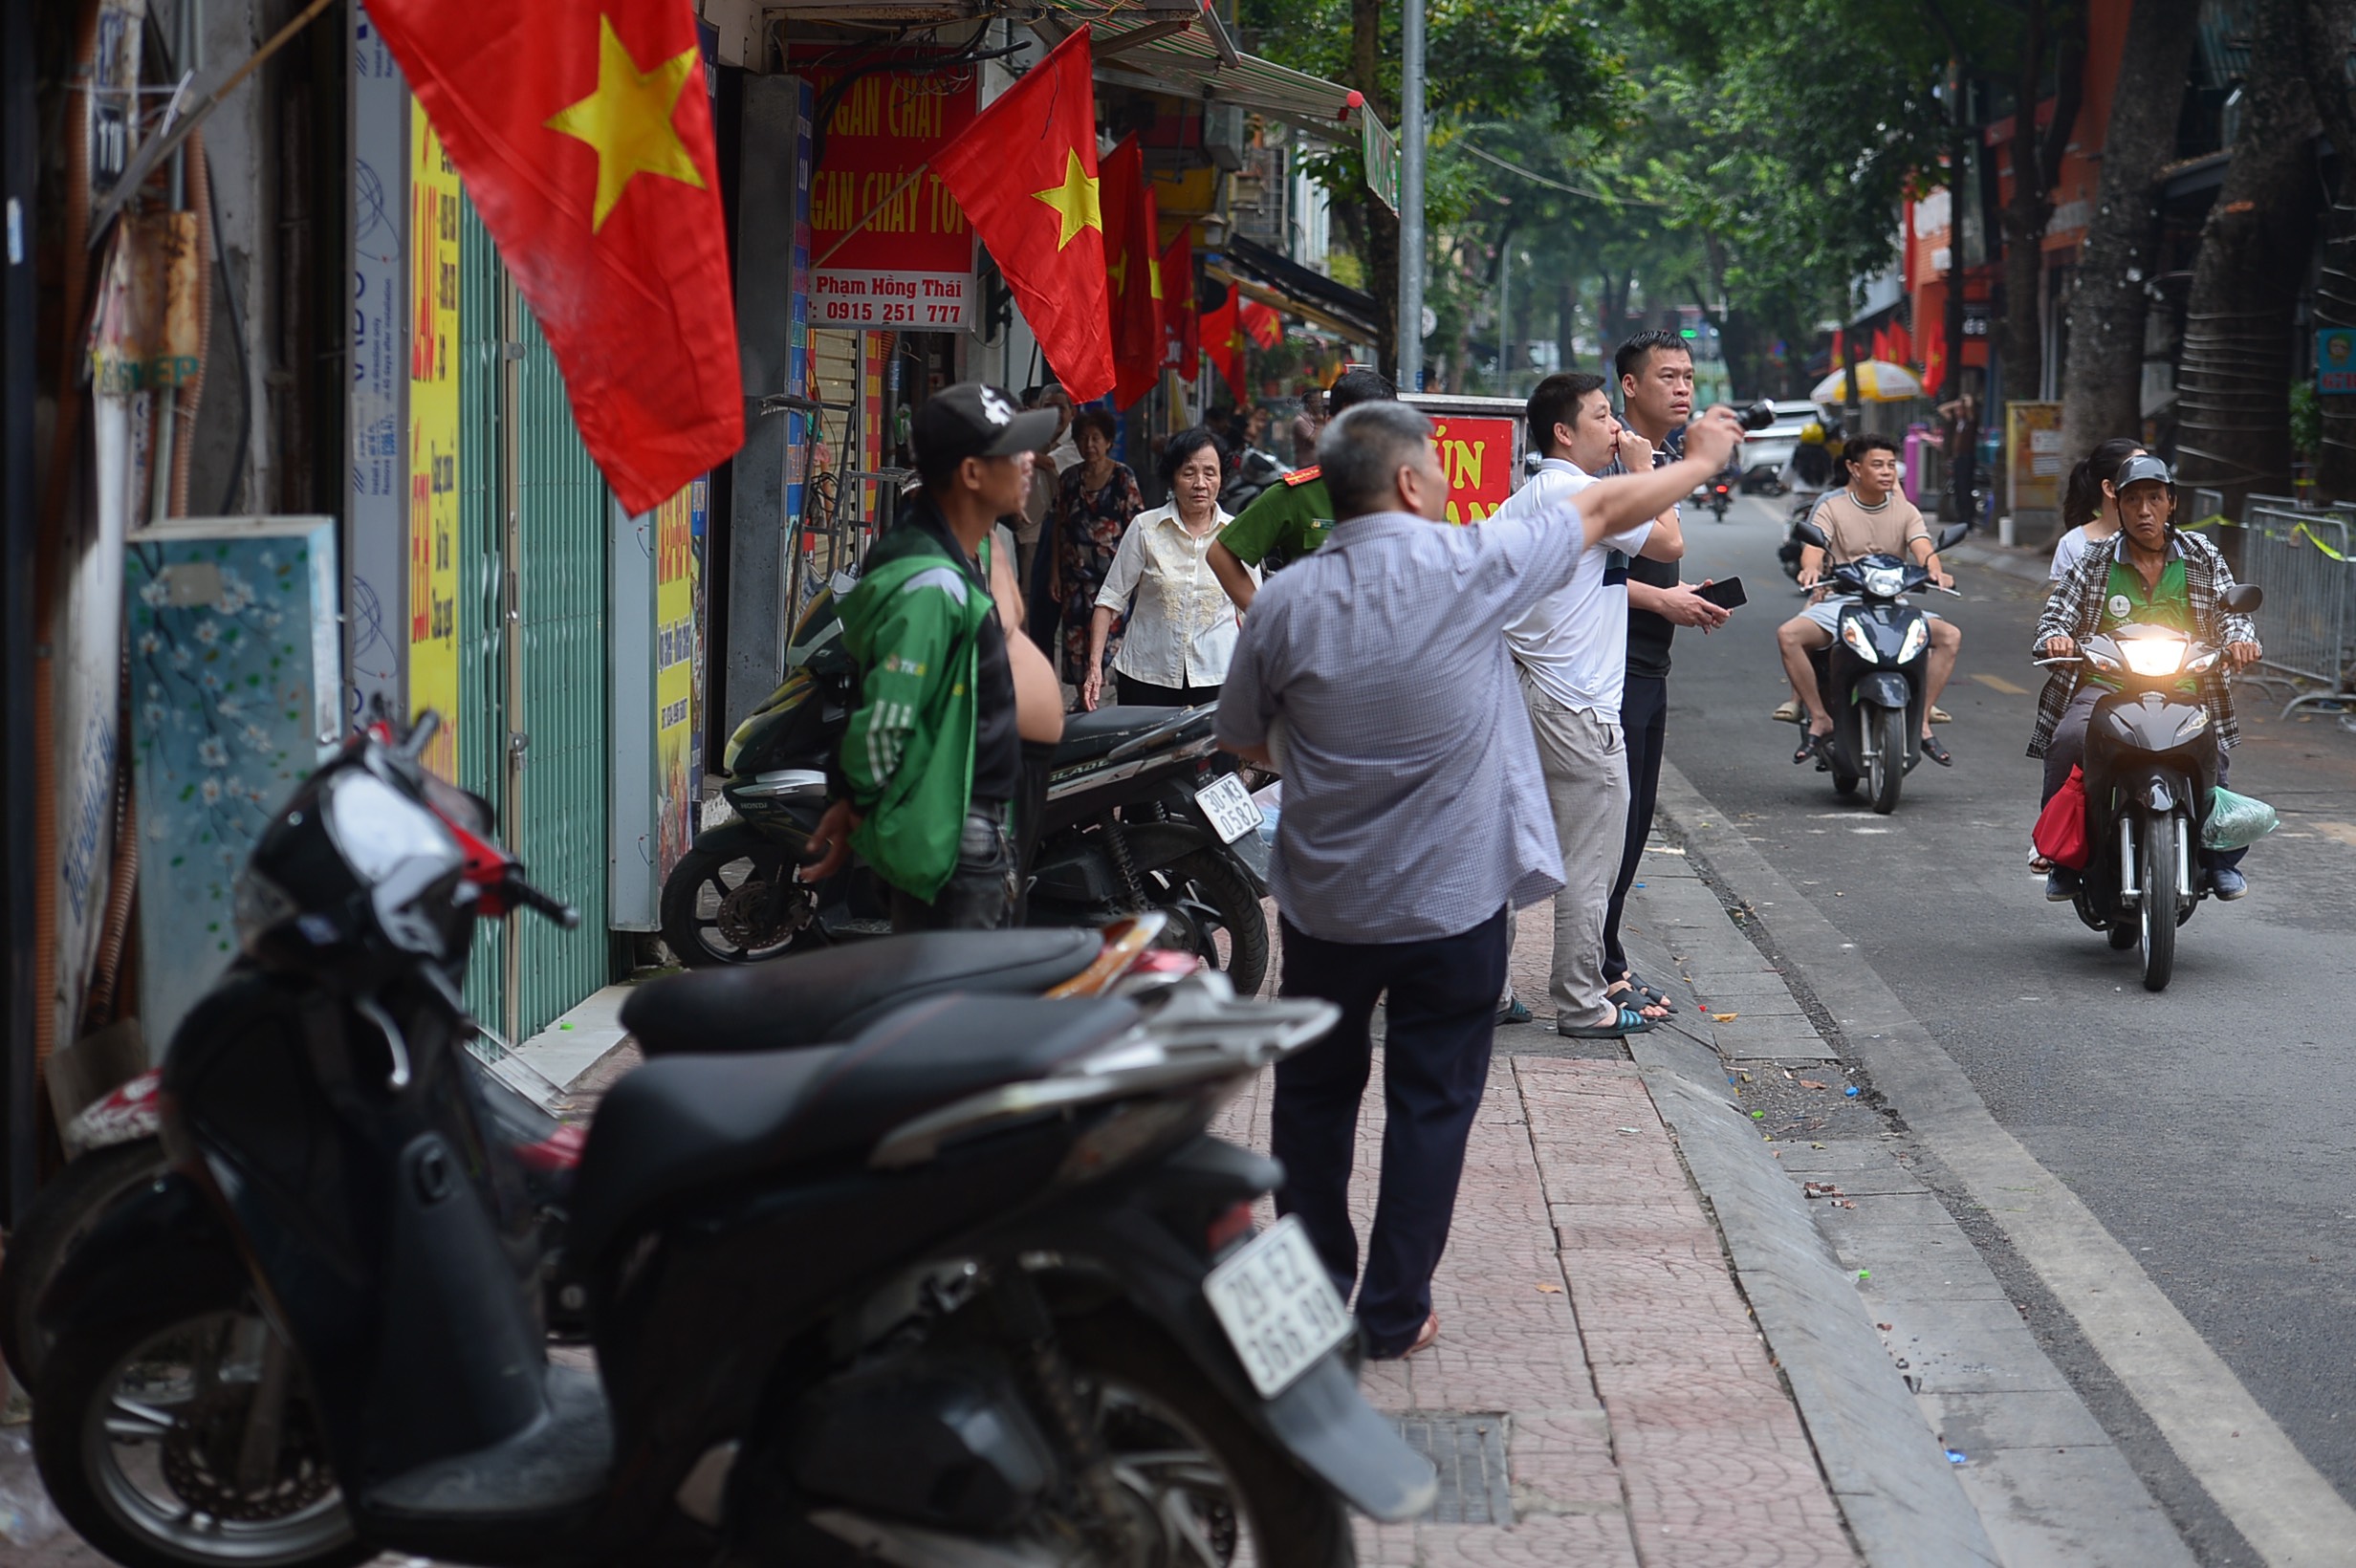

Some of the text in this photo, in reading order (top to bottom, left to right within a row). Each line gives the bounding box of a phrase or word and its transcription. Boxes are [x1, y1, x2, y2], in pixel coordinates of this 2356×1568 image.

[810, 170, 855, 231] GAN
[862, 164, 922, 233] CHÁY
[816, 275, 866, 298] Phạm
[871, 274, 917, 299] Hồng
[922, 278, 963, 298] Thái
[826, 301, 961, 323] 0915 251 777
[1220, 801, 1258, 837] 0582
